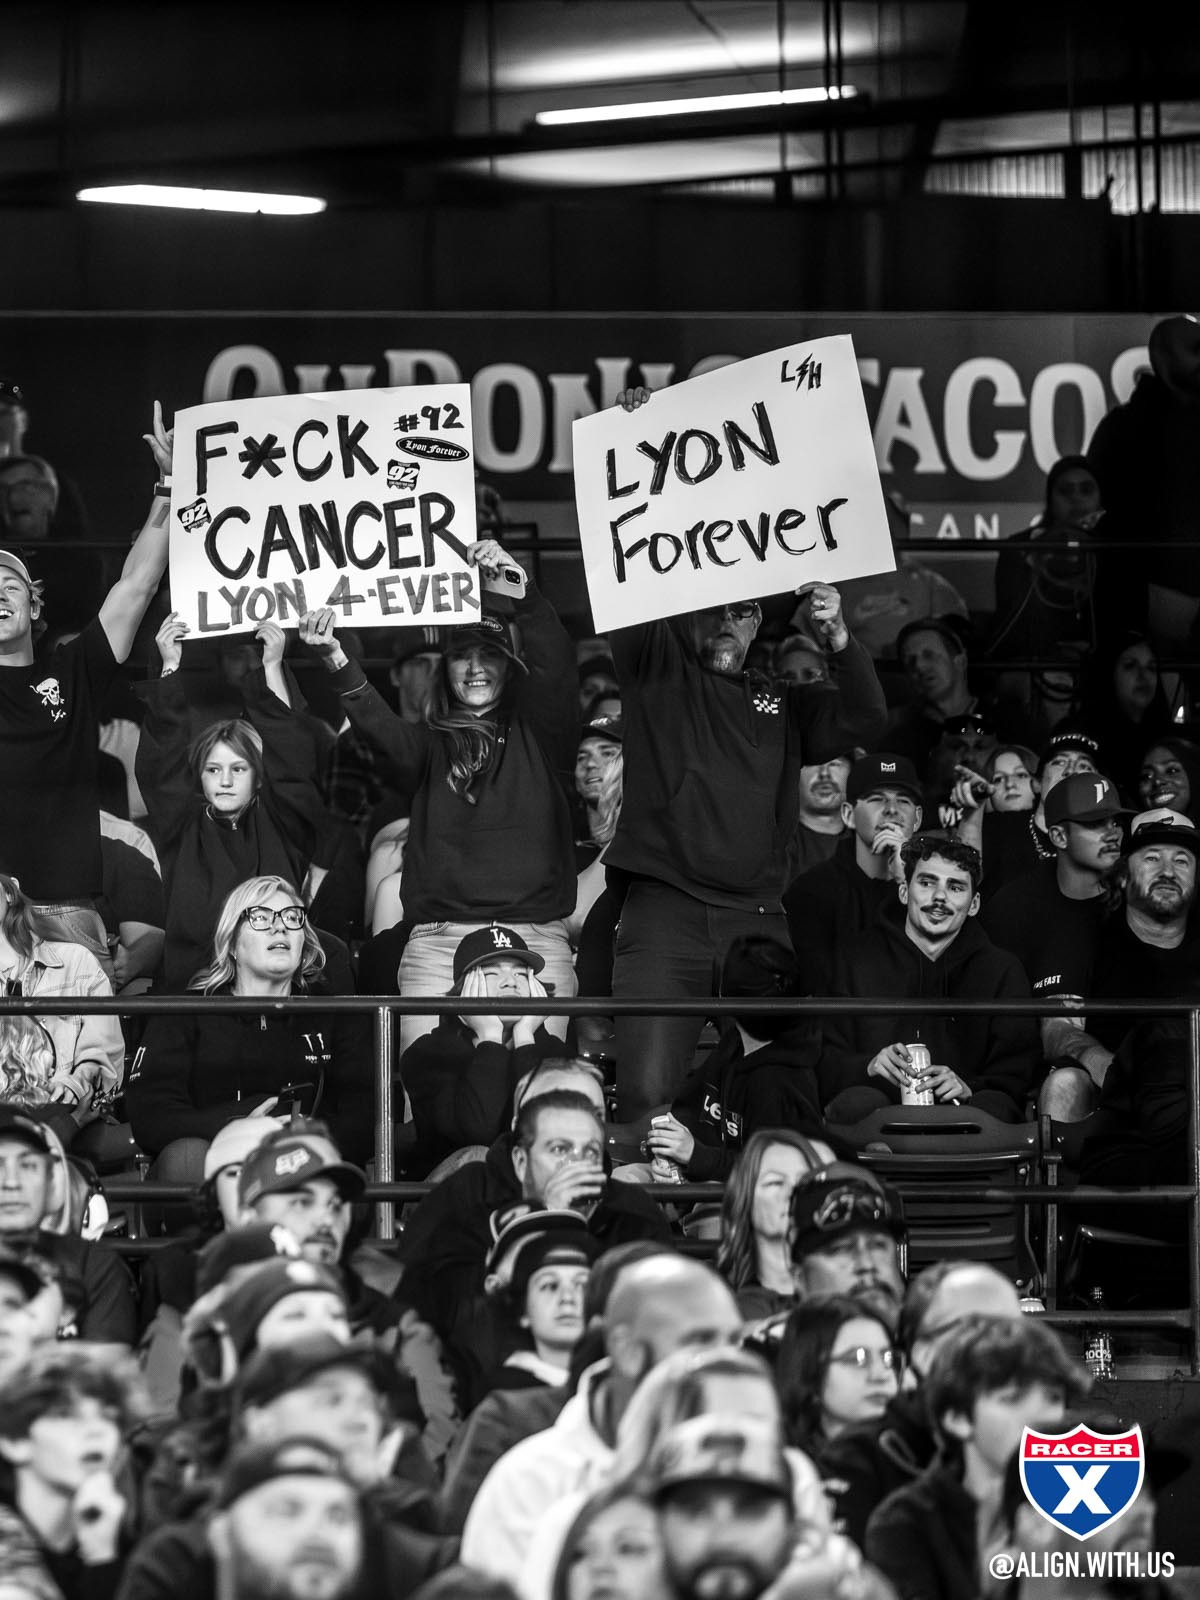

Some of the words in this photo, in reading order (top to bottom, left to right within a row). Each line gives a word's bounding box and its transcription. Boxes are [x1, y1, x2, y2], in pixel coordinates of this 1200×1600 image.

[393, 402, 465, 433] #92
[856, 346, 1157, 480] ACO
[404, 440, 428, 452] Lyon
[426, 444, 462, 458] Forever
[606, 401, 781, 501] LYON
[387, 465, 420, 483] 92
[181, 502, 208, 527] 92
[204, 491, 476, 580] CANCER
[609, 498, 849, 584] Forever
[197, 578, 309, 632] LYON
[325, 571, 481, 617] 4-EVER
[490, 928, 513, 948] LA
